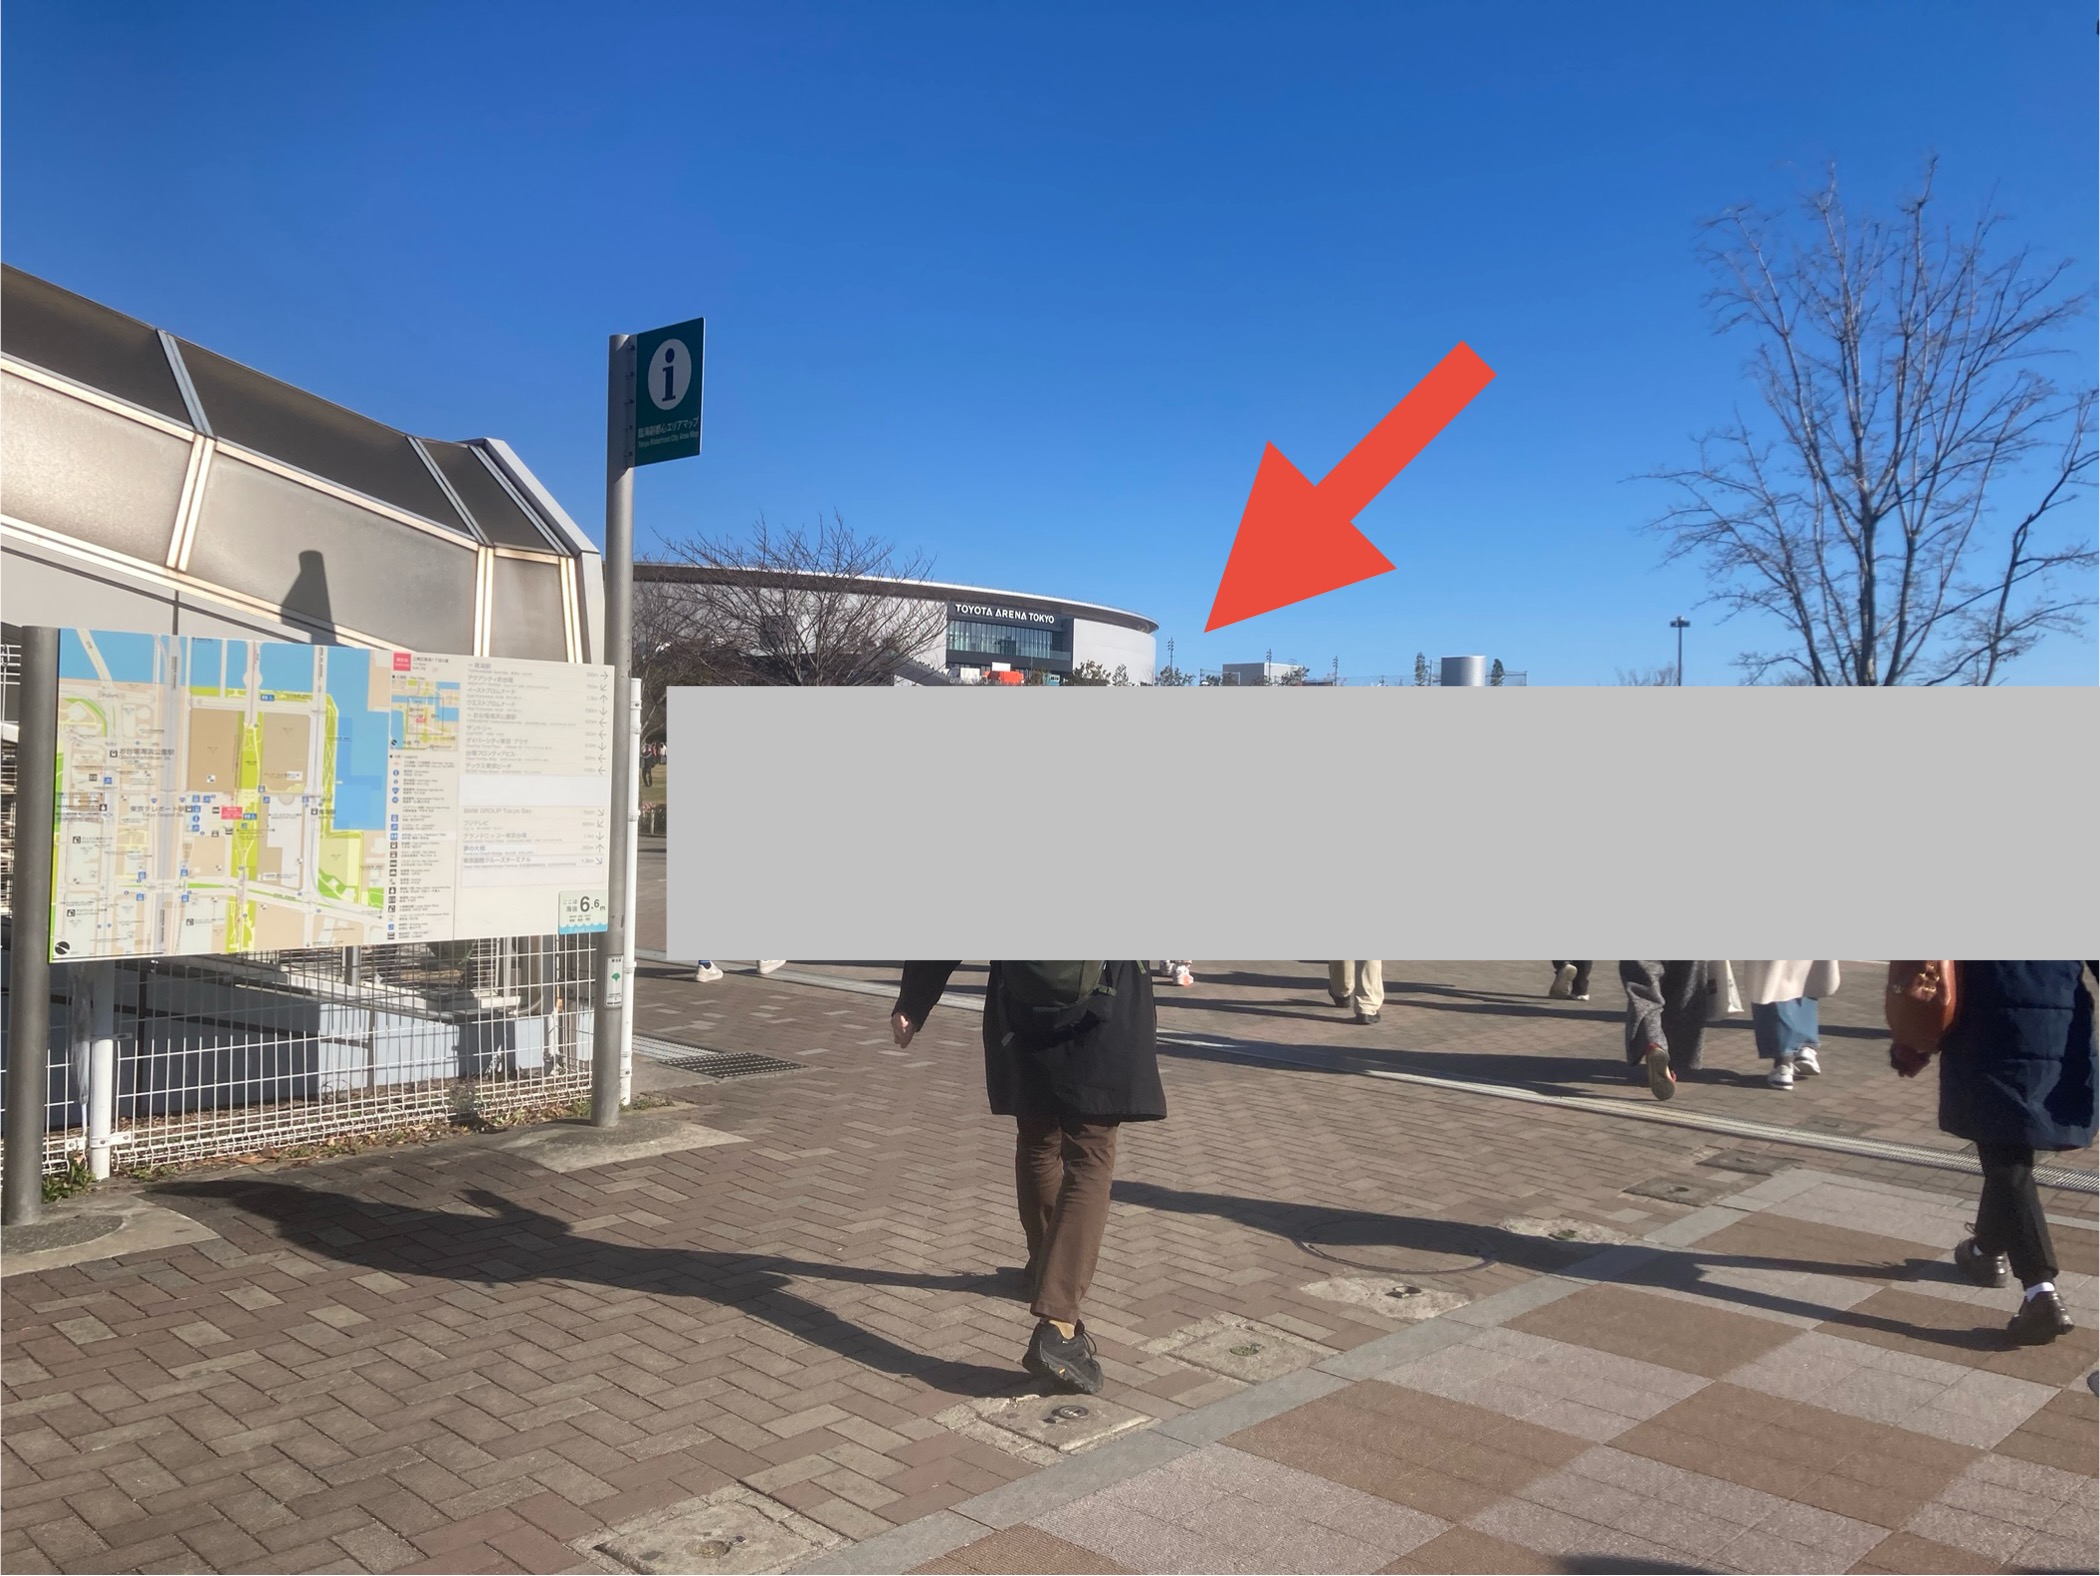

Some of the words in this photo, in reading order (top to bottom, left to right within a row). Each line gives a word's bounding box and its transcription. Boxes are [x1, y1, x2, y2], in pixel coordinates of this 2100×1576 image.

[955, 603, 993, 617] TOYOTA
[994, 608, 1027, 621] ARENA
[1028, 612, 1055, 625] TOKYO
